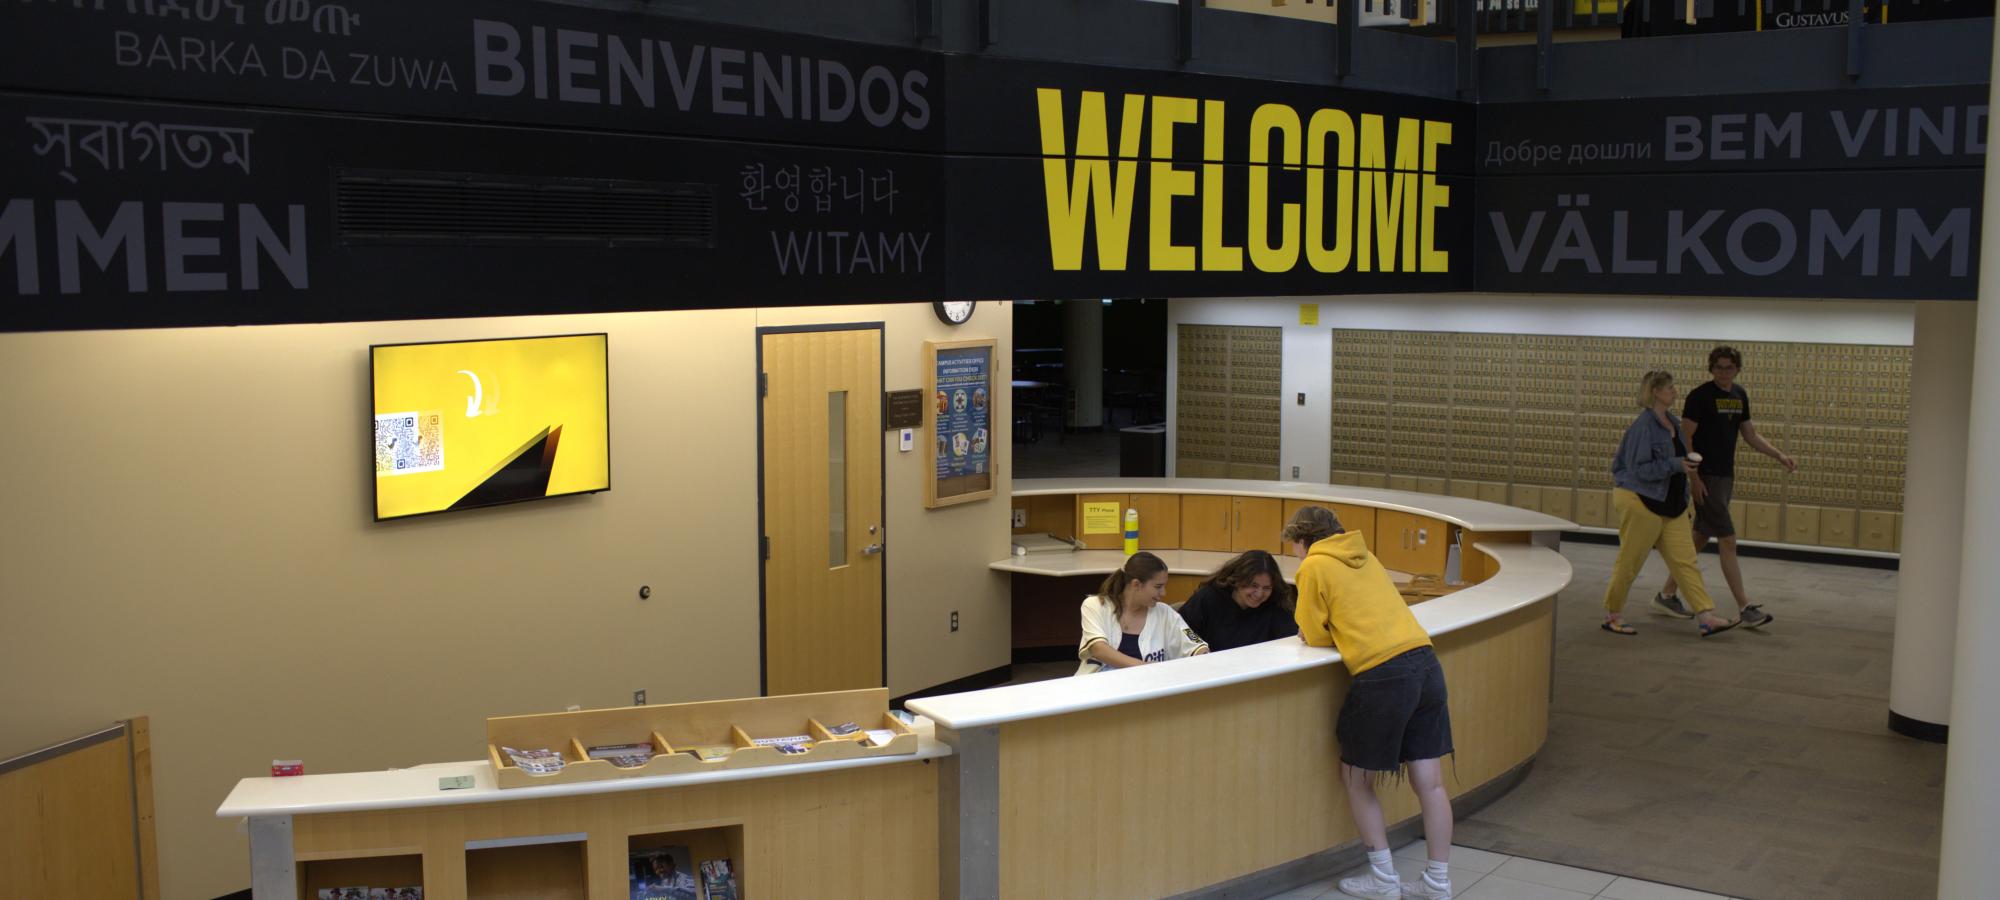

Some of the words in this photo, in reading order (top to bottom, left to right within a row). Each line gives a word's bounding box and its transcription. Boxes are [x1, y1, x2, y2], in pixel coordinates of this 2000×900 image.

[115, 30, 268, 77] BARKA
[281, 47, 337, 84] DA
[348, 54, 459, 92] ZUWA
[472, 18, 931, 131] BIENVENIDOS
[1484, 140, 1563, 169] Добре
[1567, 139, 1653, 165] дошли
[1665, 111, 1804, 162] BEM
[738, 162, 900, 216] 환영합니다
[1036, 86, 1453, 274] WELCOME
[770, 229, 932, 277] WITAMY
[1488, 193, 1972, 278] VÄLKOMM
